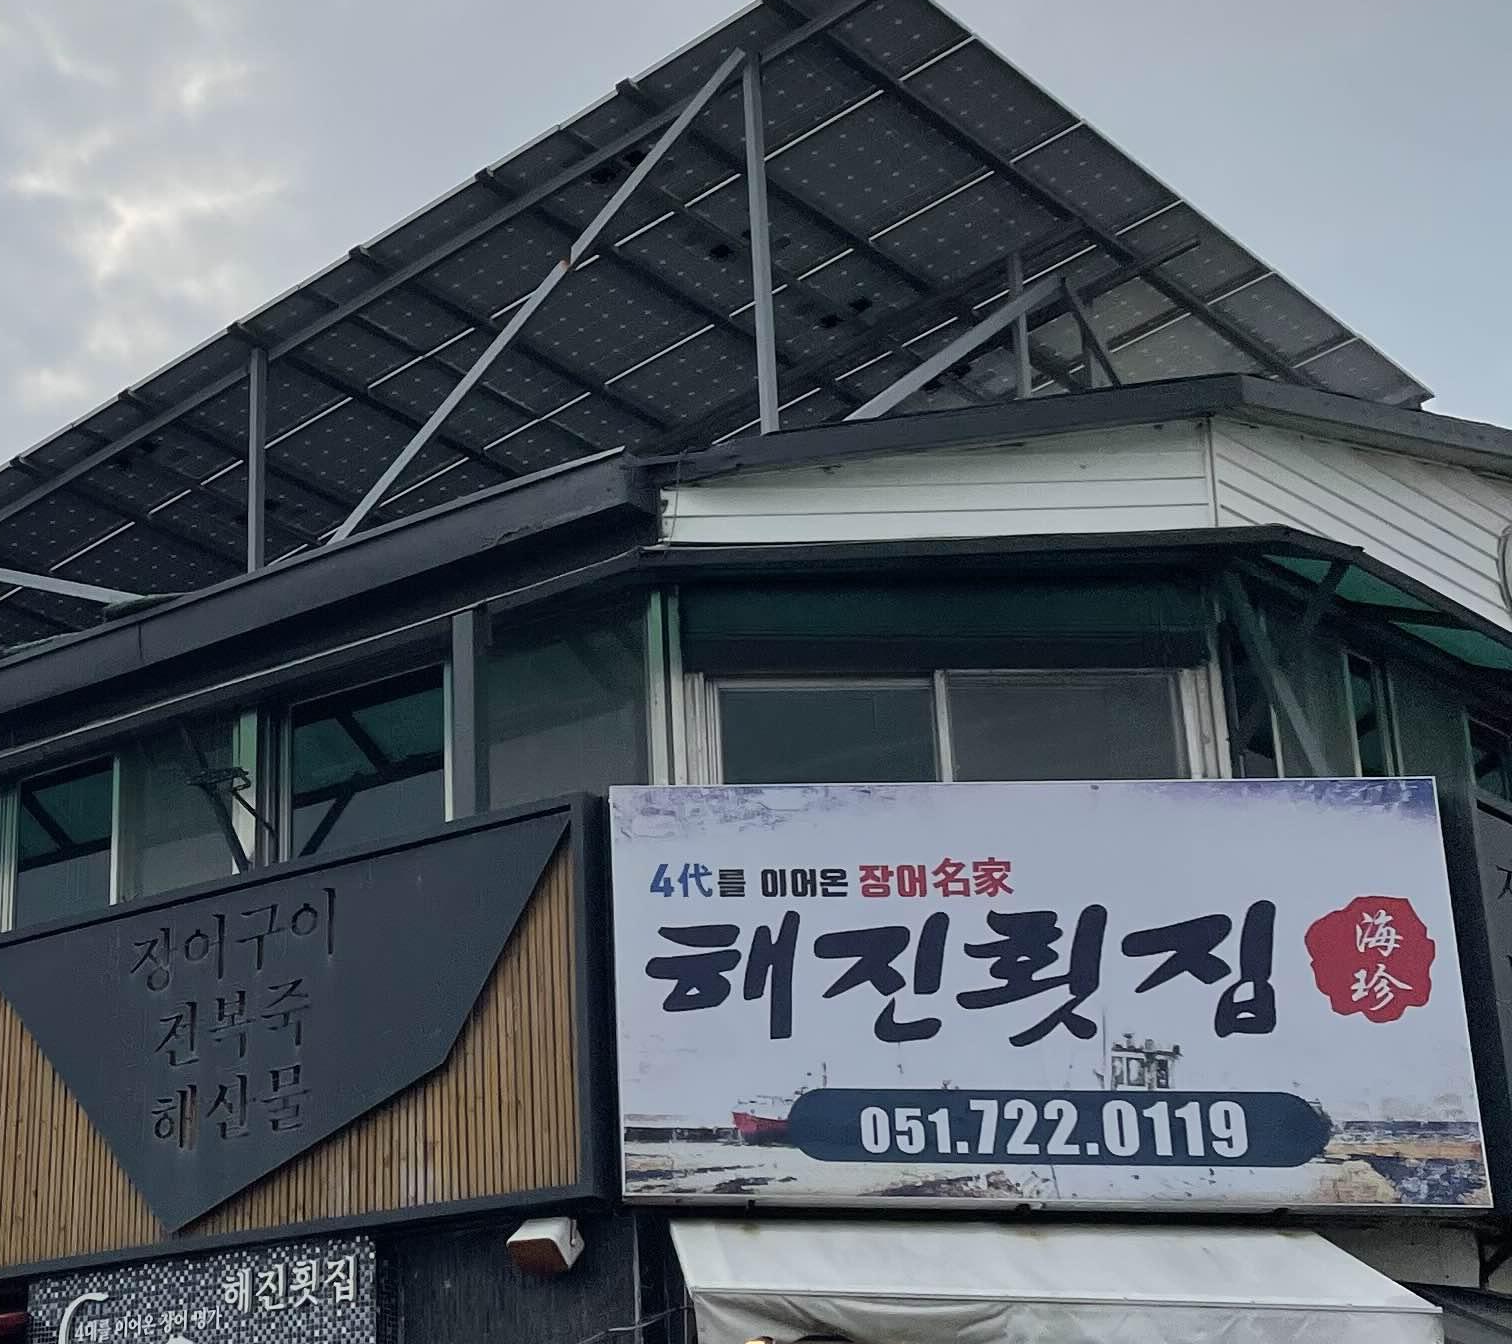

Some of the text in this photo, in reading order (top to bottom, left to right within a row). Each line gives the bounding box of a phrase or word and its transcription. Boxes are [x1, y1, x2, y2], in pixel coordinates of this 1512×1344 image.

[649, 857, 1015, 899] 4代를 이어온 장어名家
[130, 887, 337, 992] 장어구이
[645, 900, 1278, 1048] 해진횟집
[154, 978, 313, 1069] 전복죽
[151, 1064, 313, 1150] 해산물
[859, 1097, 1250, 1159] 051.722.0119
[223, 1254, 361, 1313] 해진횟집
[74, 1317, 112, 1343] 4대를
[114, 1312, 157, 1339] 이어온
[159, 1309, 189, 1334] 장어
